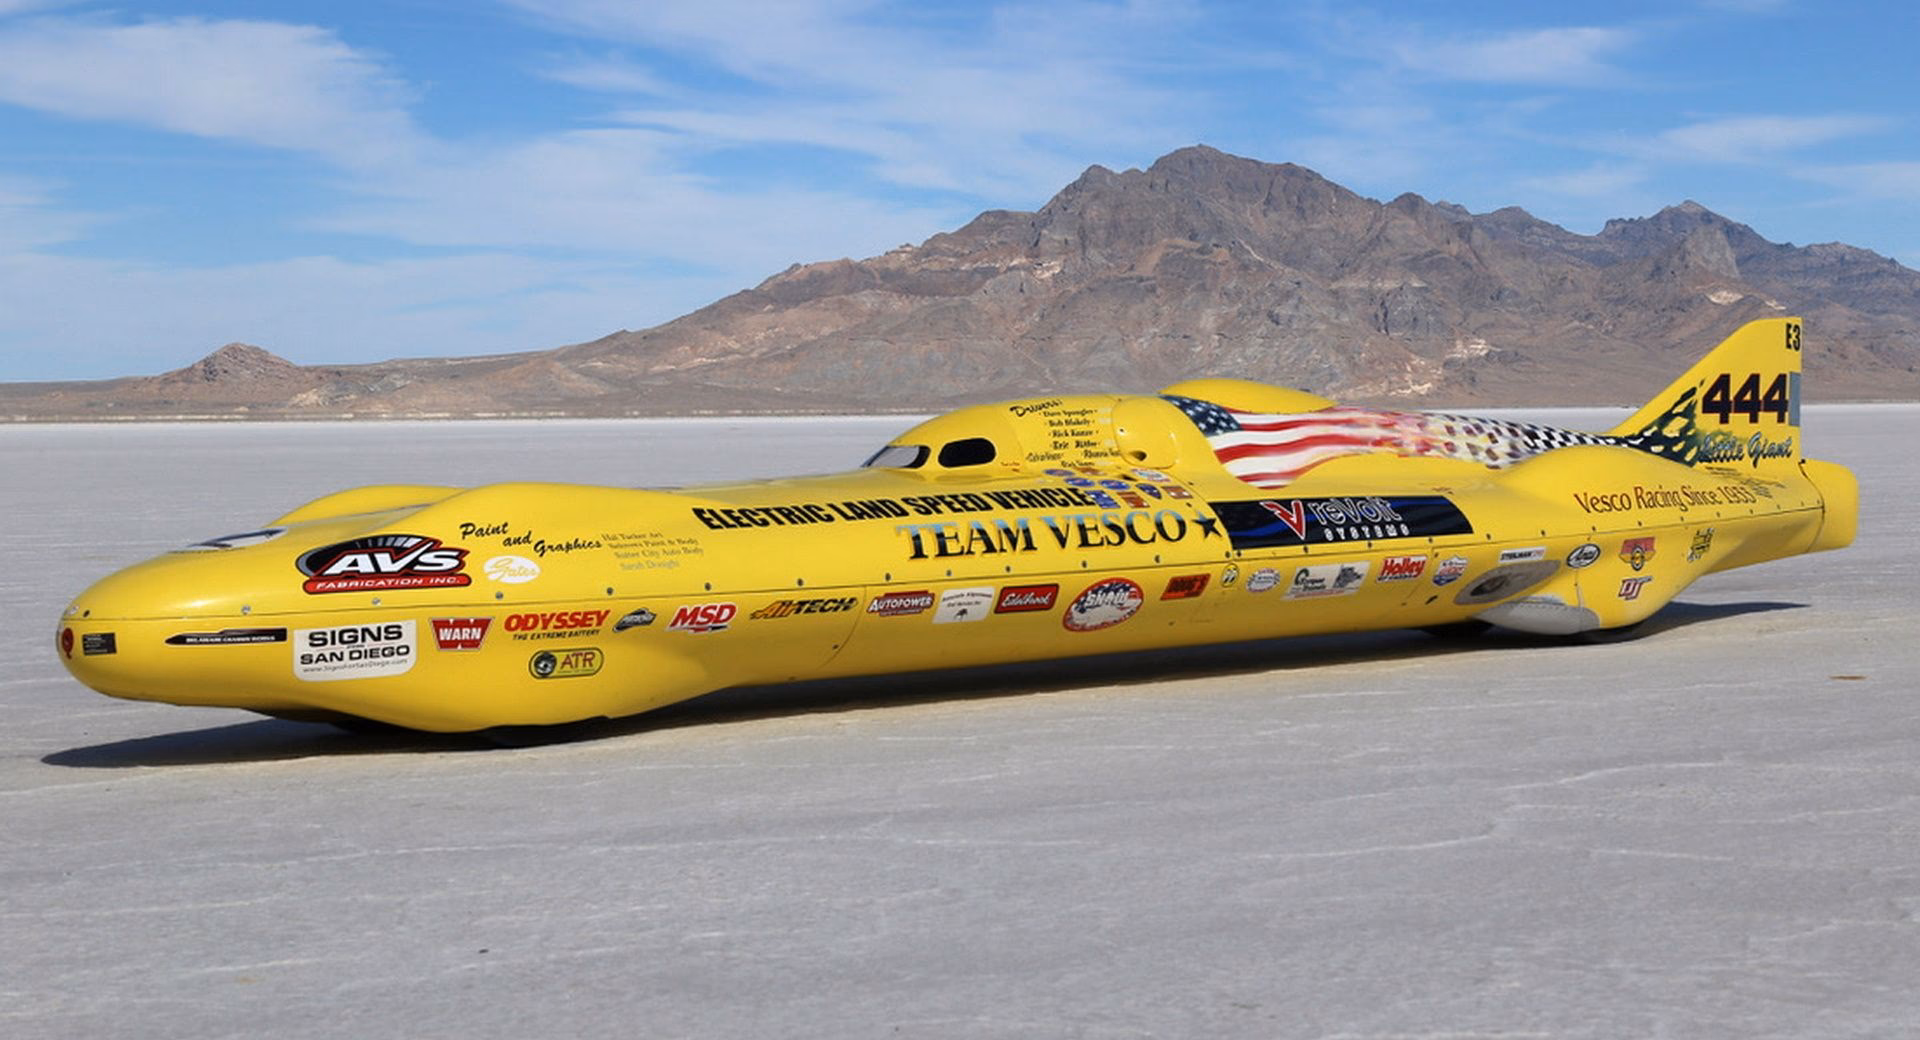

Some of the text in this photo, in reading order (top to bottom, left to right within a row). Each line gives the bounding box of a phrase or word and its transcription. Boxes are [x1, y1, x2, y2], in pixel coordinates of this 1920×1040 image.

[1785, 322, 1801, 352] E3
[1701, 373, 1789, 425] 444
[1747, 431, 1793, 469] Giant
[692, 487, 1098, 530] ELECTRIC LAND SPEED VEHICLE
[1573, 492, 1632, 514] Vesco
[1633, 485, 1689, 512] Racing
[1680, 485, 1724, 507] Since
[459, 522, 509, 540] Paint
[502, 530, 532, 547] and
[894, 509, 1188, 561] TEAM VESCO
[321, 542, 460, 576] AVS
[533, 538, 602, 557] Graphics
[1380, 557, 1425, 577] Holley
[315, 576, 461, 590] FABRICATION INC.
[504, 609, 611, 632] ODYSSEY
[670, 603, 737, 628] MSD
[308, 624, 403, 648] SIGNS
[438, 627, 482, 641] WARN
[530, 631, 568, 640] EXTREME
[567, 629, 600, 637] BATTERY
[300, 644, 410, 665] SAN DIEGO
[560, 651, 597, 670] ATR
